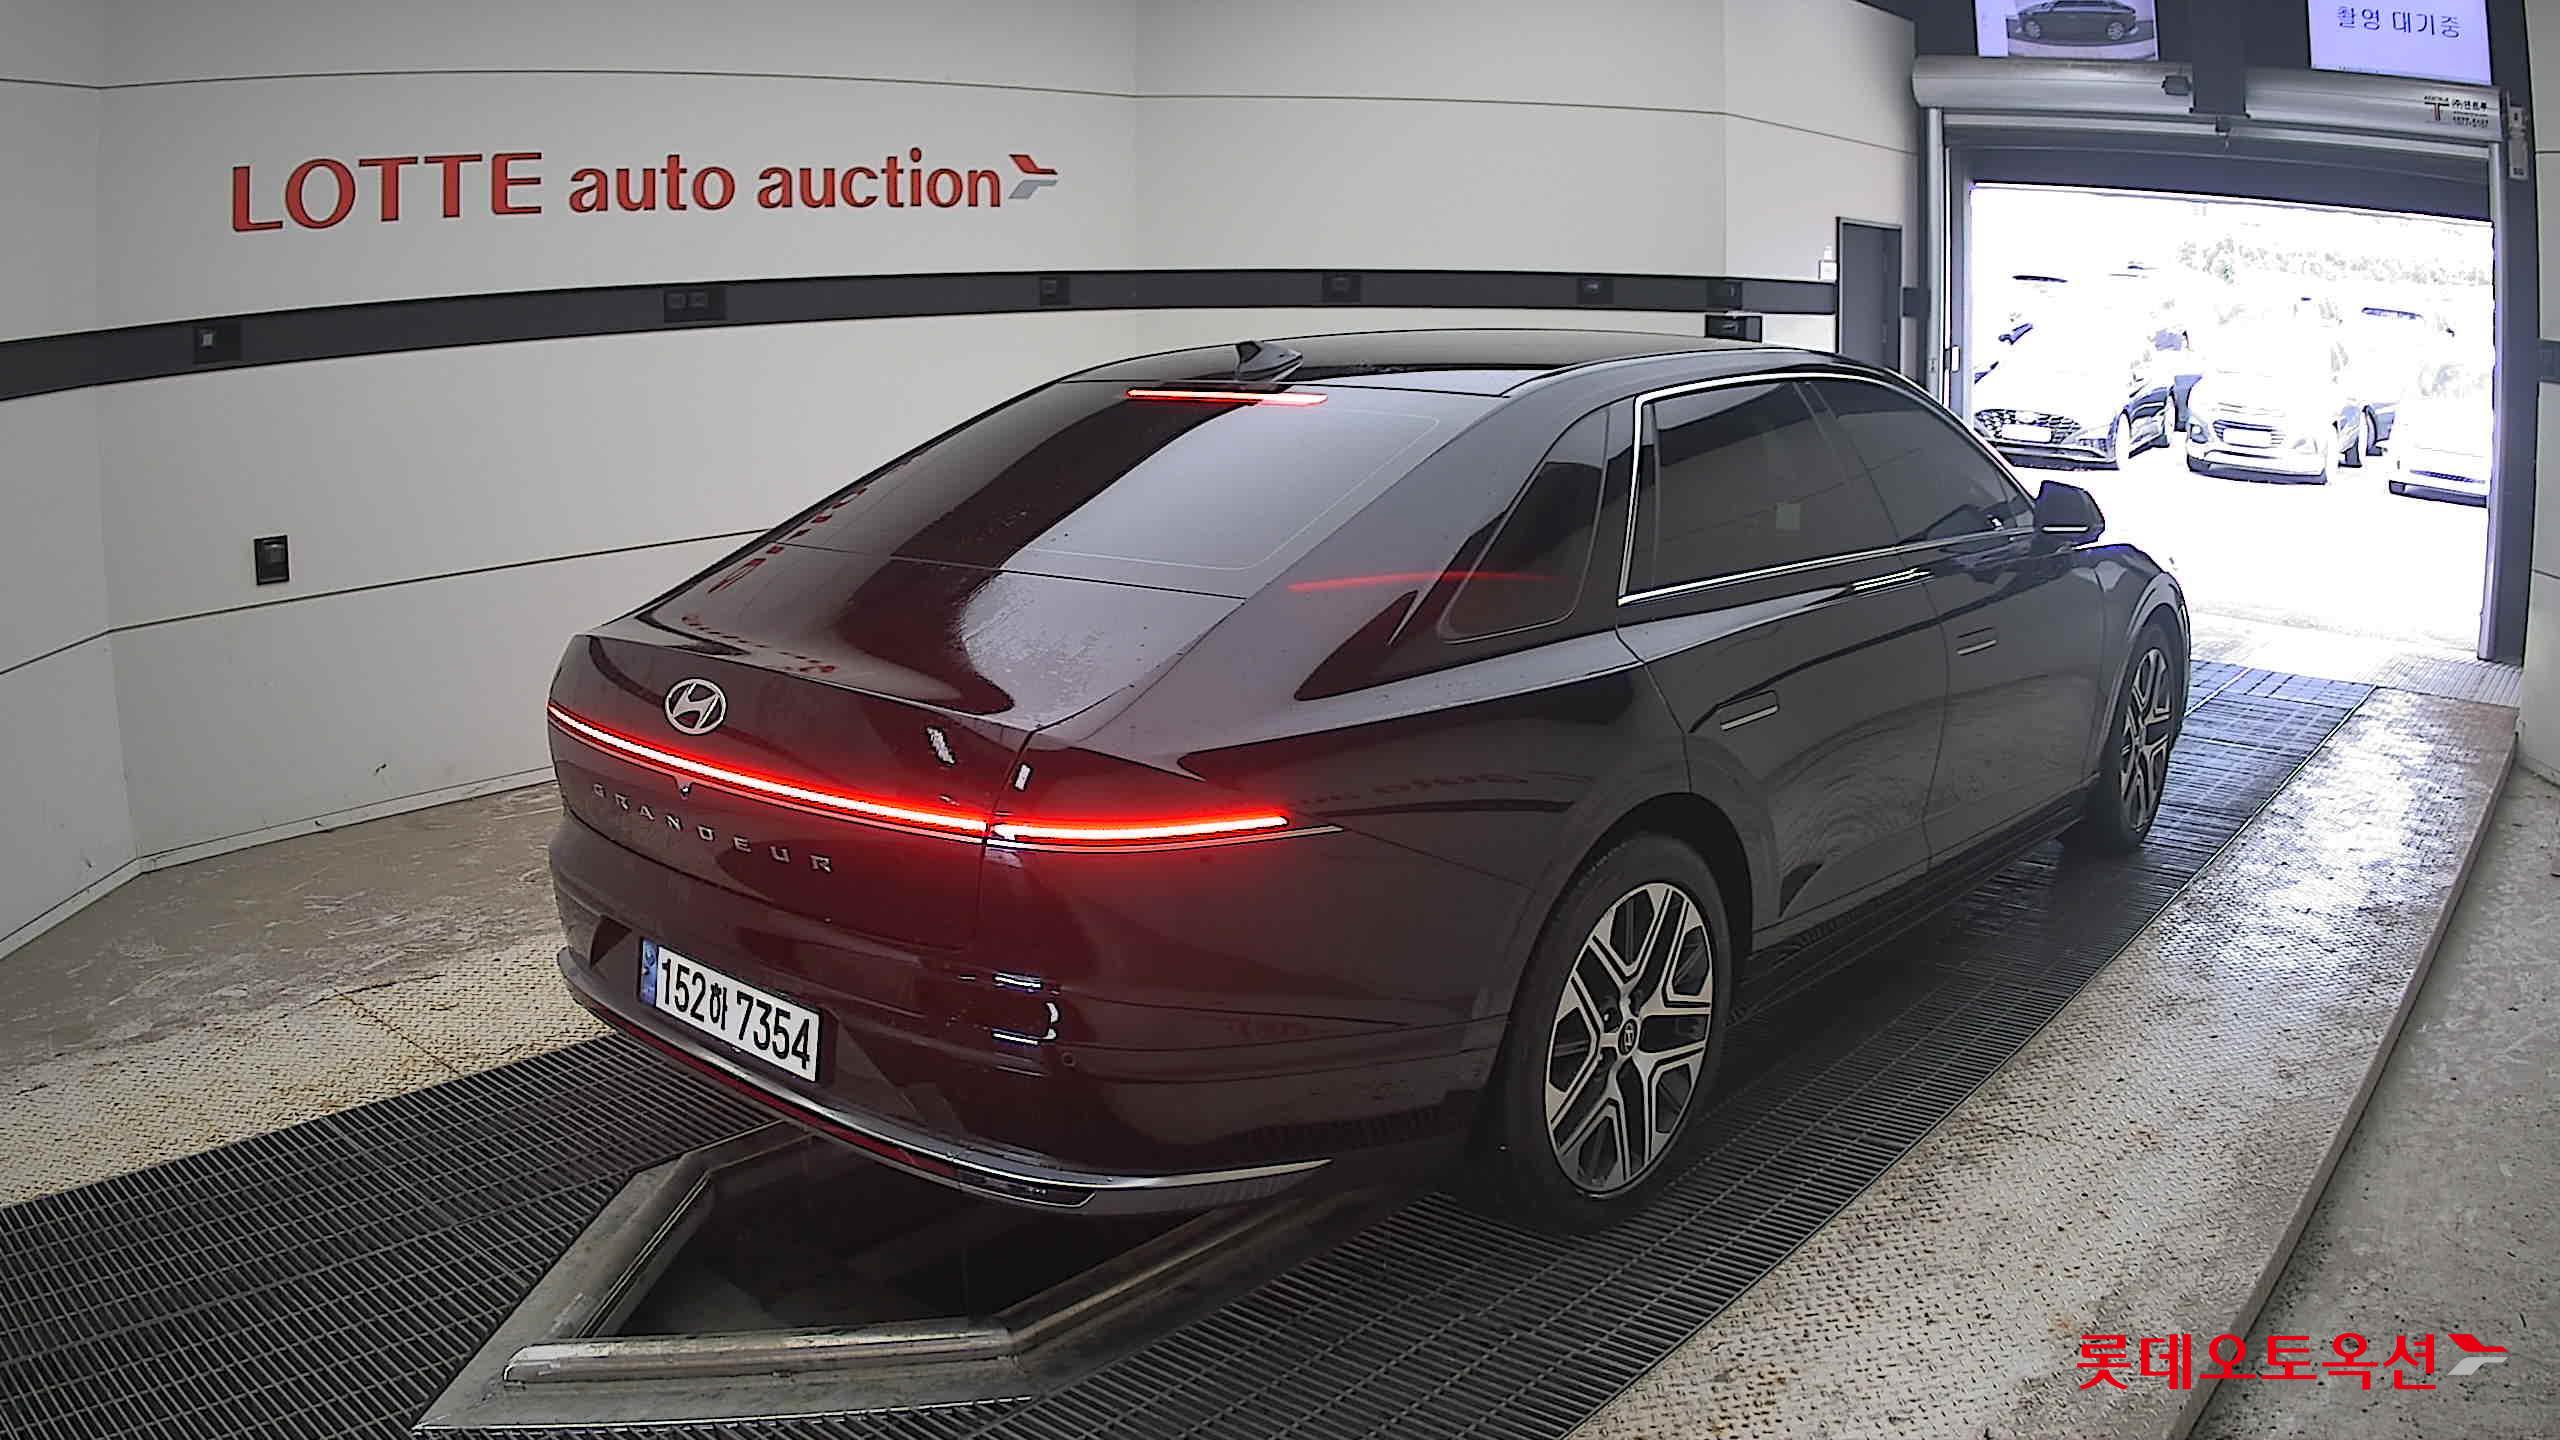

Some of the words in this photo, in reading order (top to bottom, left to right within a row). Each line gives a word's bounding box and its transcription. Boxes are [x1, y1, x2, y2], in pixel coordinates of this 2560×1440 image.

[2338, 6, 2380, 31] 촬영
[2392, 11, 2460, 38] 대기중
[232, 152, 542, 233] LOTTE
[568, 153, 736, 214] auto
[756, 146, 1001, 209] auction
[591, 783, 833, 872] GRANDEUR
[661, 957, 728, 1031] 152하
[736, 990, 811, 1070] 7354
